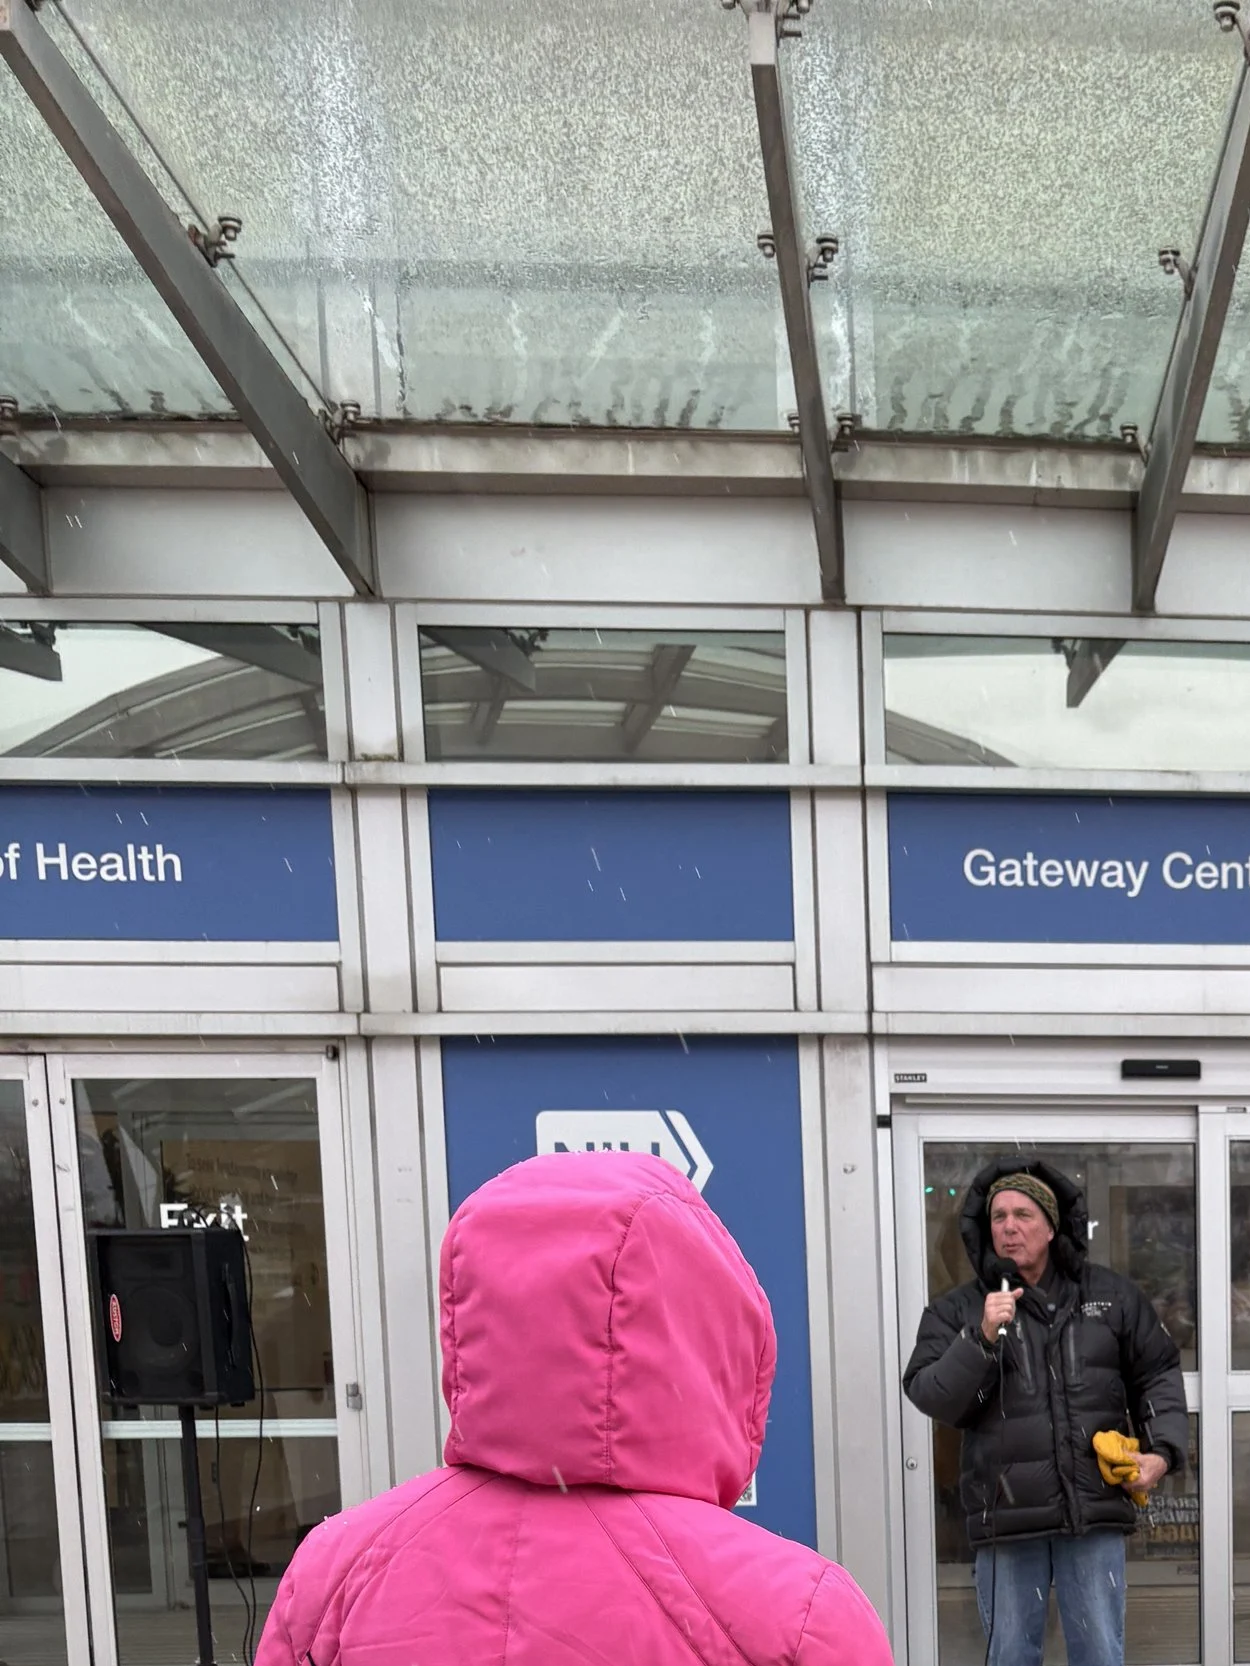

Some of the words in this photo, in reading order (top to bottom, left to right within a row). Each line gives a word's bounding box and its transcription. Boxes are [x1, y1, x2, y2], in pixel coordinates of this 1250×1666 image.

[0, 842, 21, 881] f
[36, 842, 183, 882] Health
[963, 848, 1149, 897] Gateway
[159, 1202, 250, 1242] Exit
